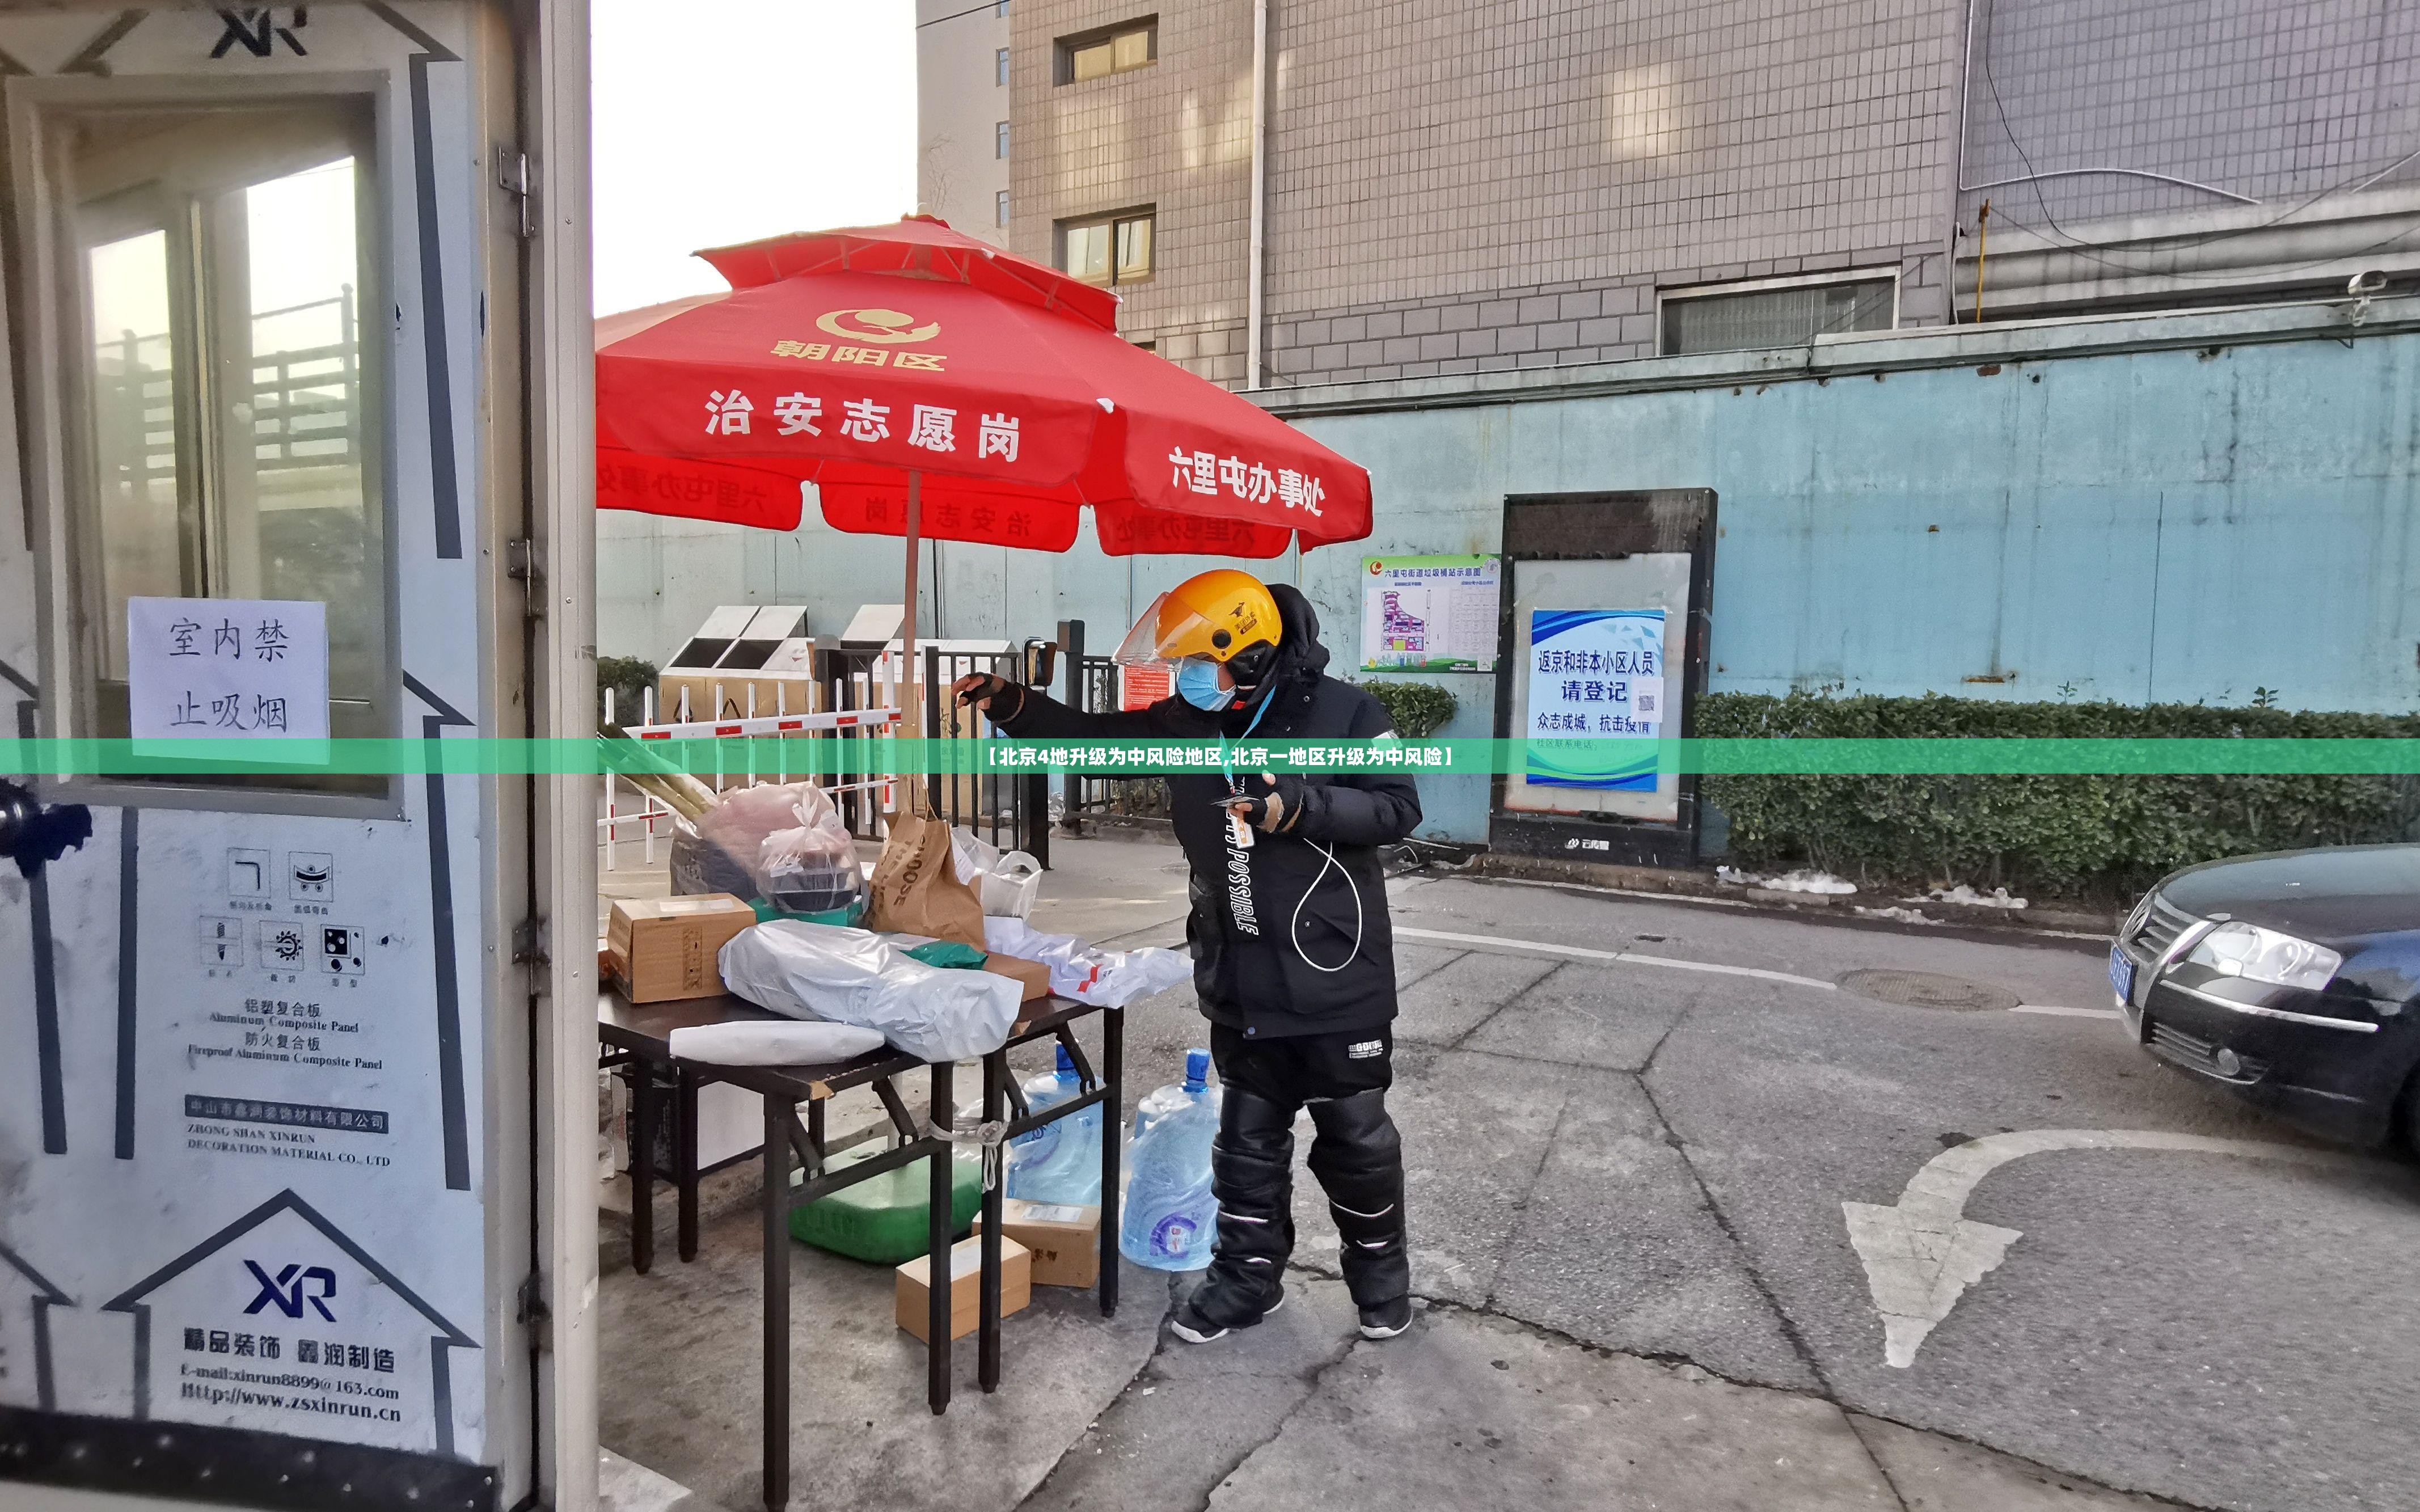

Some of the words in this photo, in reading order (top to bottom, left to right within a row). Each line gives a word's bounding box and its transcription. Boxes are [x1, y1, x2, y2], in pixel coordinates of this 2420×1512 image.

[770, 340, 948, 372] 朝阳区
[704, 389, 1020, 463] 治安志愿岗
[1169, 446, 1325, 517] 六里屯办事处
[168, 617, 290, 662] 室内禁
[1538, 649, 1654, 674] 返京和非本小区人员
[1562, 681, 1628, 702] 请登记
[170, 690, 288, 733] 止吸烟
[1227, 847, 1259, 936] POSSIBLE
[209, 1012, 264, 1025] Aluminum
[269, 1016, 327, 1031] Composite
[331, 1021, 358, 1033] Panel
[244, 998, 322, 1018] 铝塑复合板
[244, 1032, 321, 1051] 防火复合板
[294, 1053, 350, 1067] Composite
[355, 1058, 382, 1070] Panel
[188, 1139, 267, 1155] DECORATION
[271, 1146, 334, 1162] MATERIAL
[243, 1260, 337, 1322] XR
[184, 1327, 280, 1359] 精品装饰
